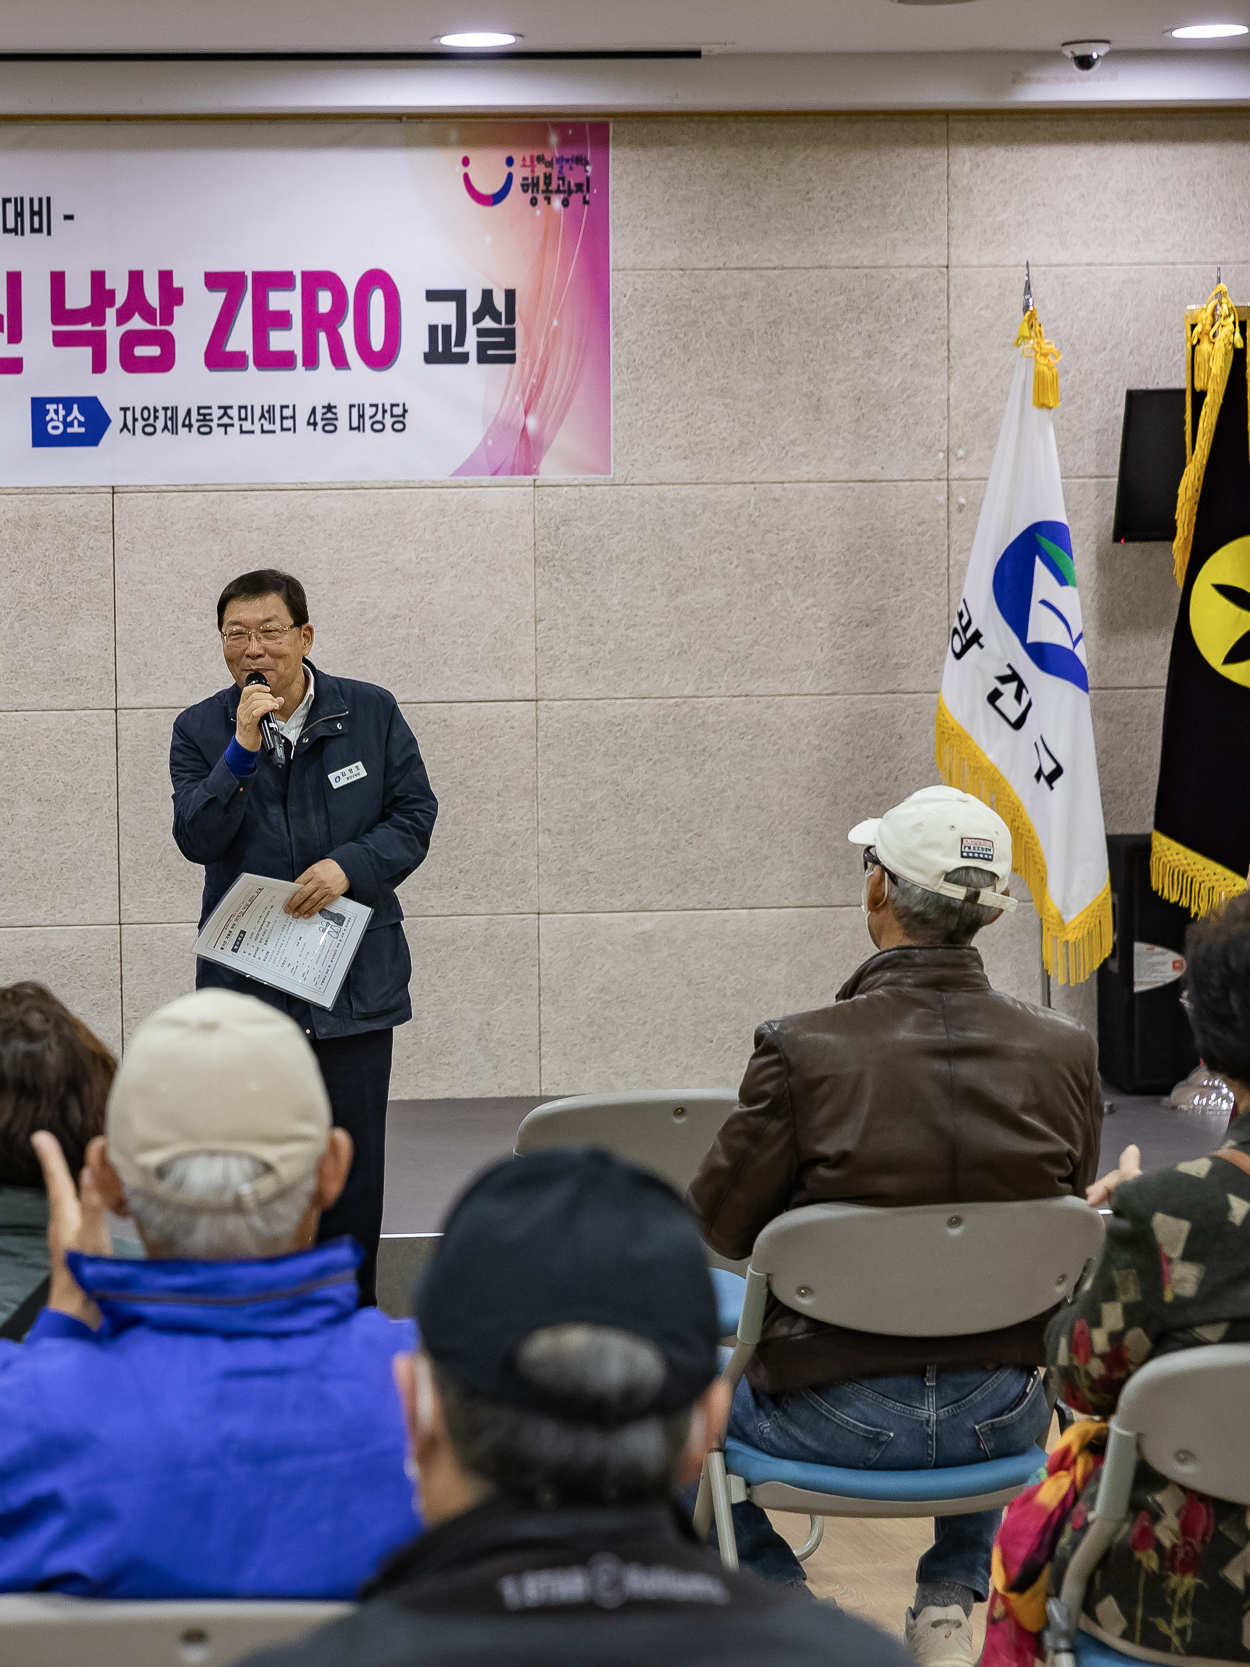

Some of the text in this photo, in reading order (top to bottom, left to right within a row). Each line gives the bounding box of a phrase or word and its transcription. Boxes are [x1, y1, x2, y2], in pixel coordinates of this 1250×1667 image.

[520, 172, 590, 208] 행복광진
[1, 195, 52, 237] 대비
[49, 269, 184, 375] 낙상
[203, 268, 402, 372] ZERO
[423, 288, 517, 365] 교실
[45, 402, 409, 437] 장소 자양제4동주민센터 4층 대강당
